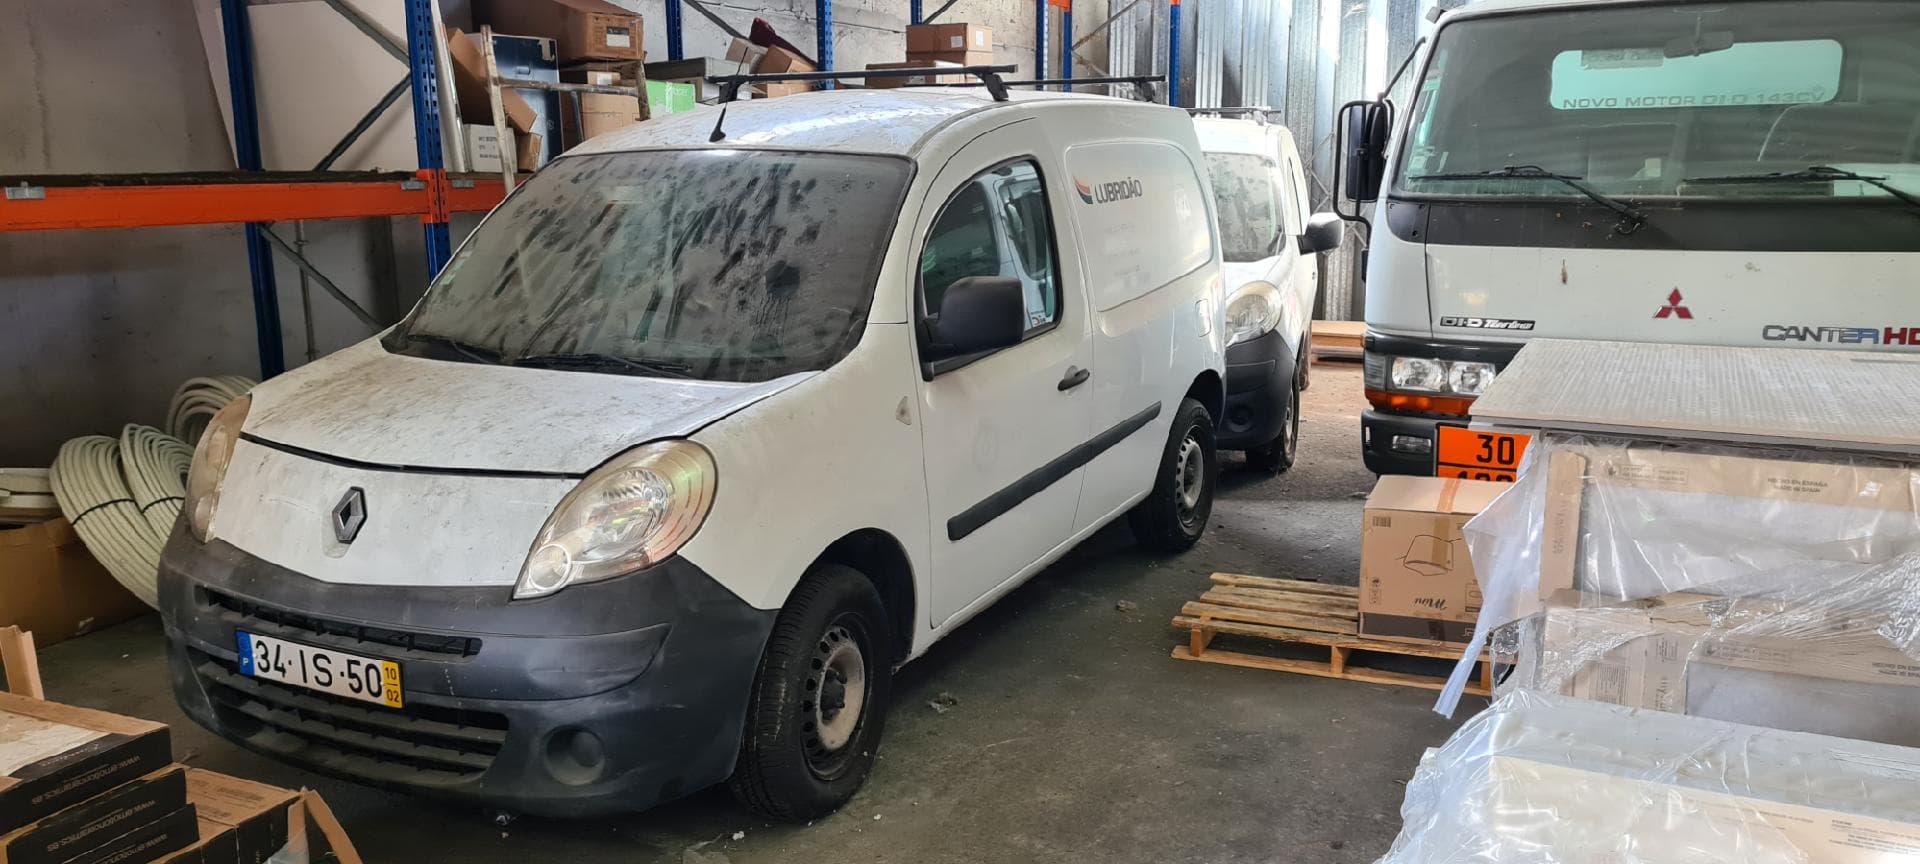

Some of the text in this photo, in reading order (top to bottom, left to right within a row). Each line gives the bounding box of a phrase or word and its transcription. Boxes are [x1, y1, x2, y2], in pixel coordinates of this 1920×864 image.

[1563, 98, 1618, 109] NOVO
[1625, 95, 1695, 107] MOTOR
[1757, 92, 1826, 103] 143CV
[1094, 176, 1143, 204] LUBRIDÃO
[1762, 325, 1880, 345] CANTER
[1476, 434, 1515, 466] 30
[384, 666, 397, 681] 10
[386, 690, 400, 703] 02
